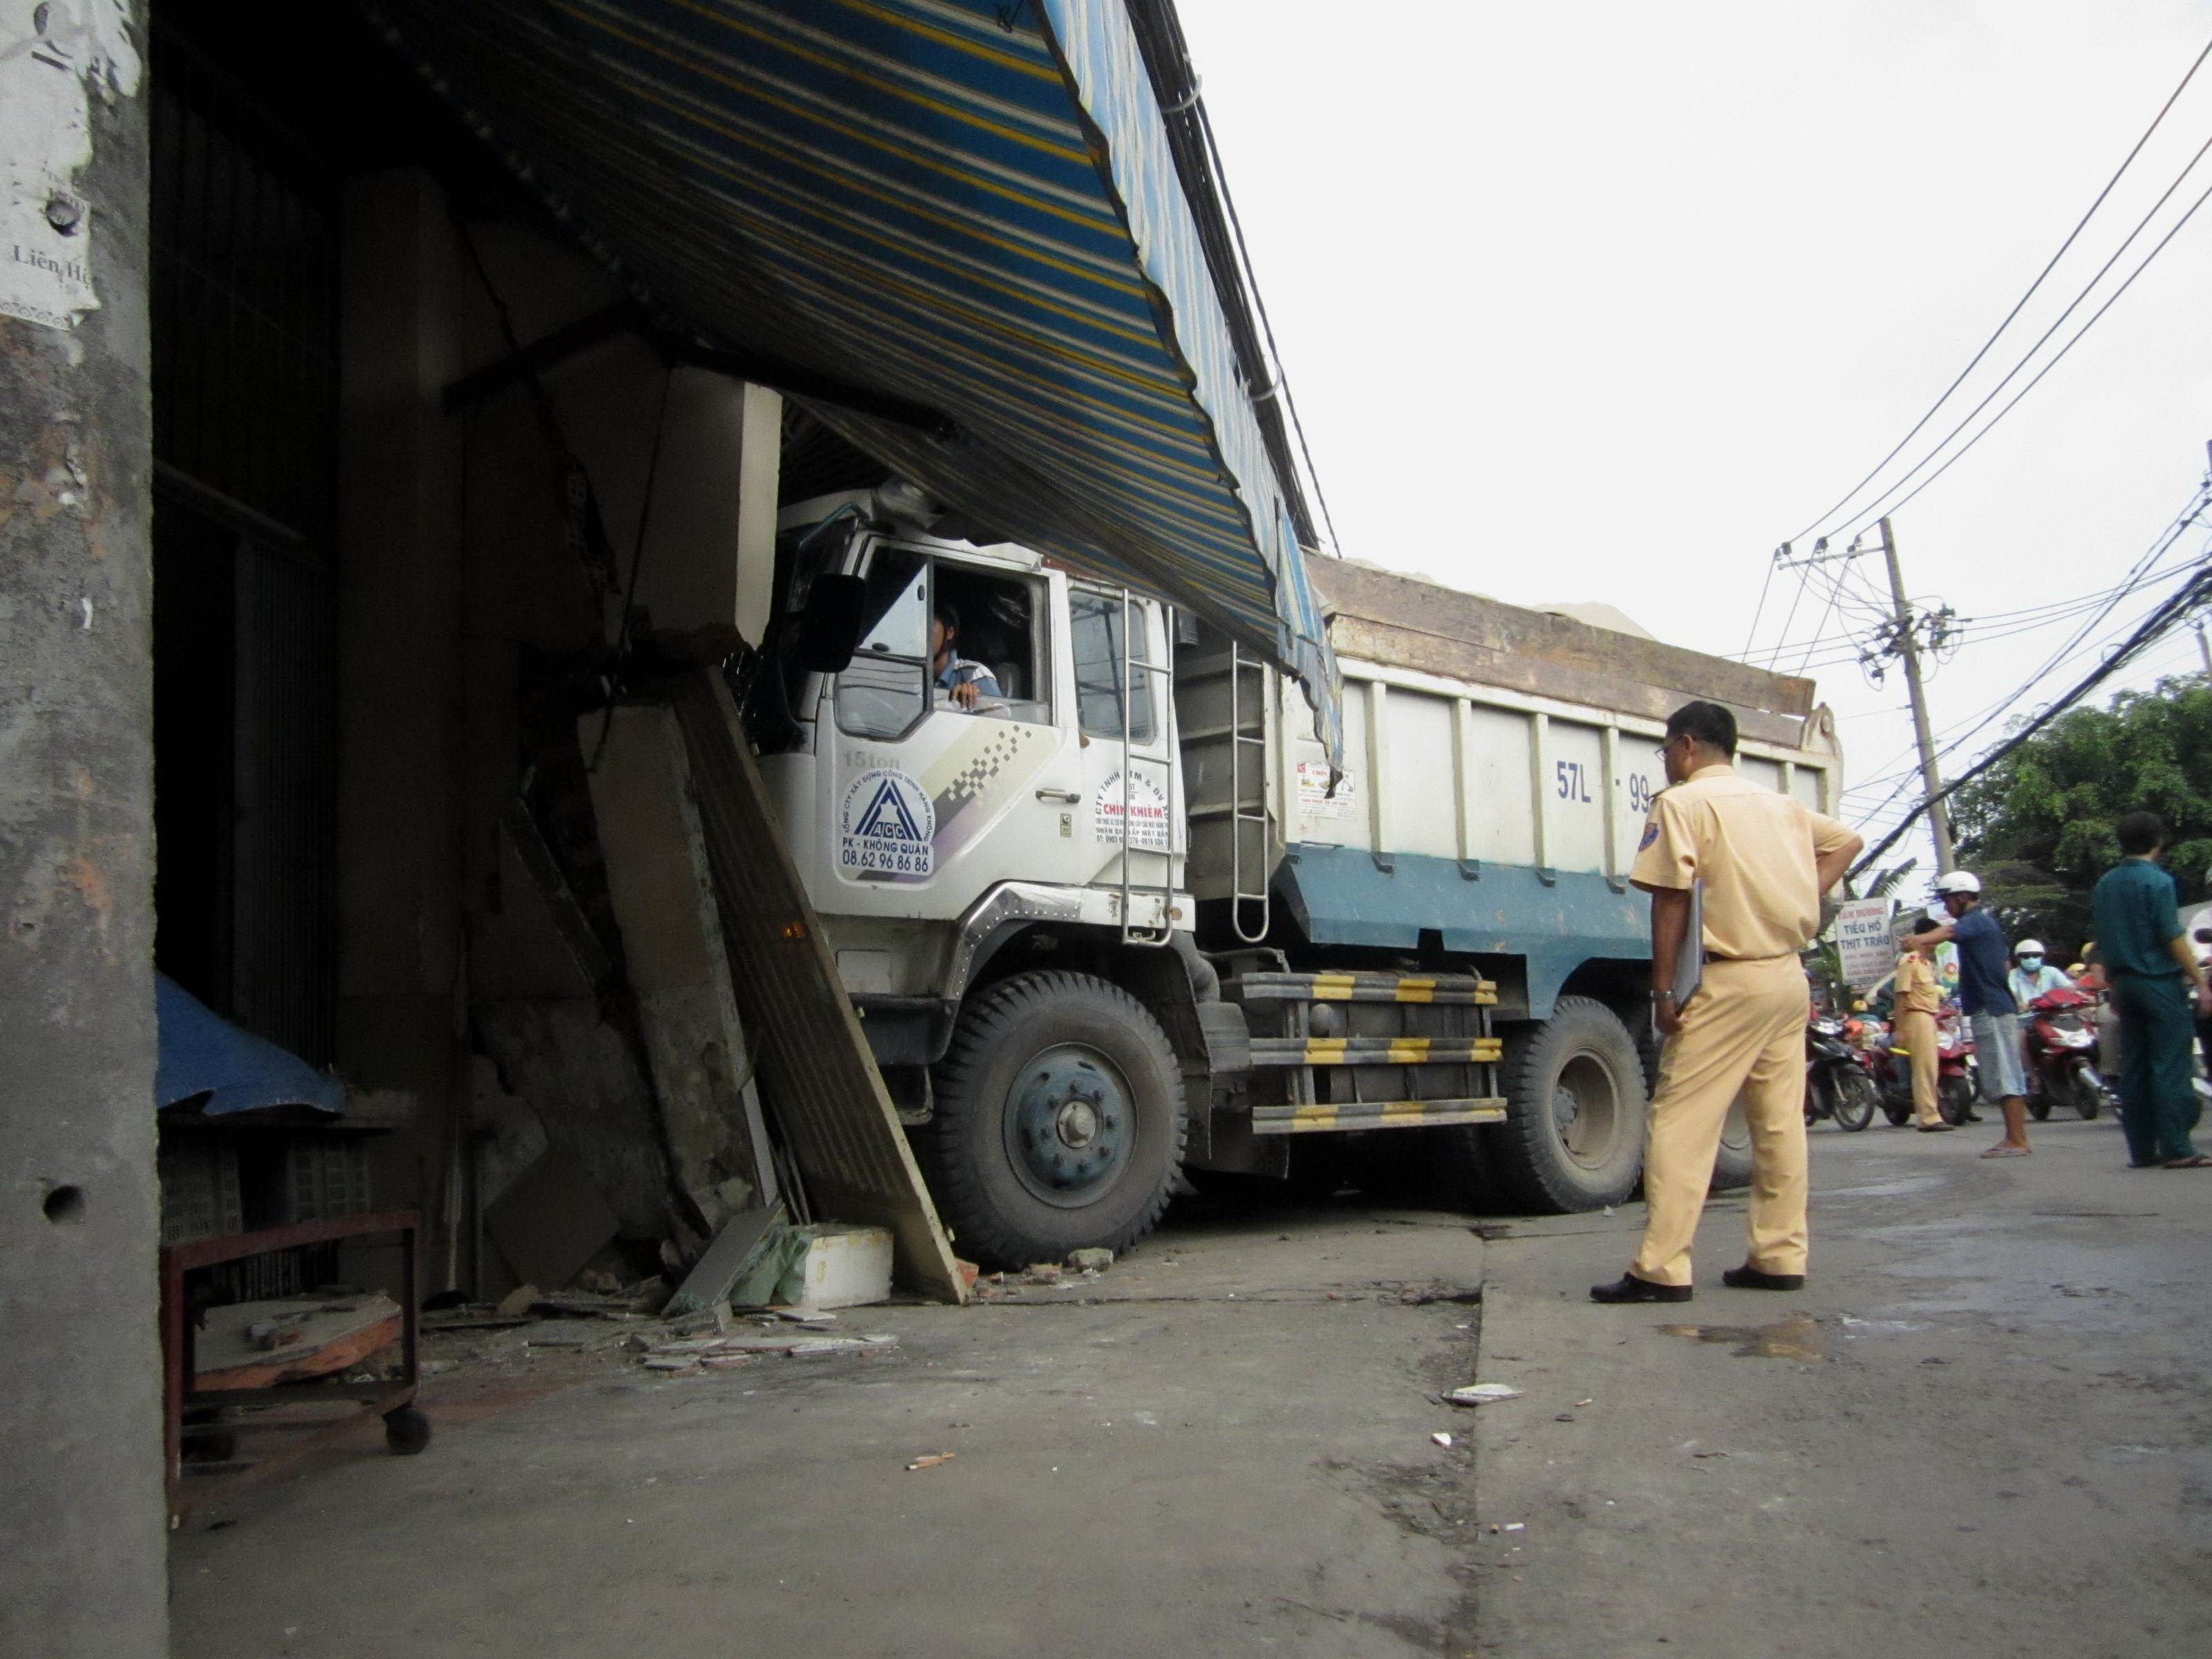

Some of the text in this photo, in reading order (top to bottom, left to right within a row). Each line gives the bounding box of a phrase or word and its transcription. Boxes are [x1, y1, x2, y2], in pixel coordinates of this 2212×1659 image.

[1557, 760, 1591, 803] 57L
[871, 822, 906, 838] ACC
[843, 837, 853, 847] PK
[863, 838, 897, 852] KHÔNG
[900, 843, 928, 856] QUÂN
[843, 850, 928, 872] 08.62 96 86 86
